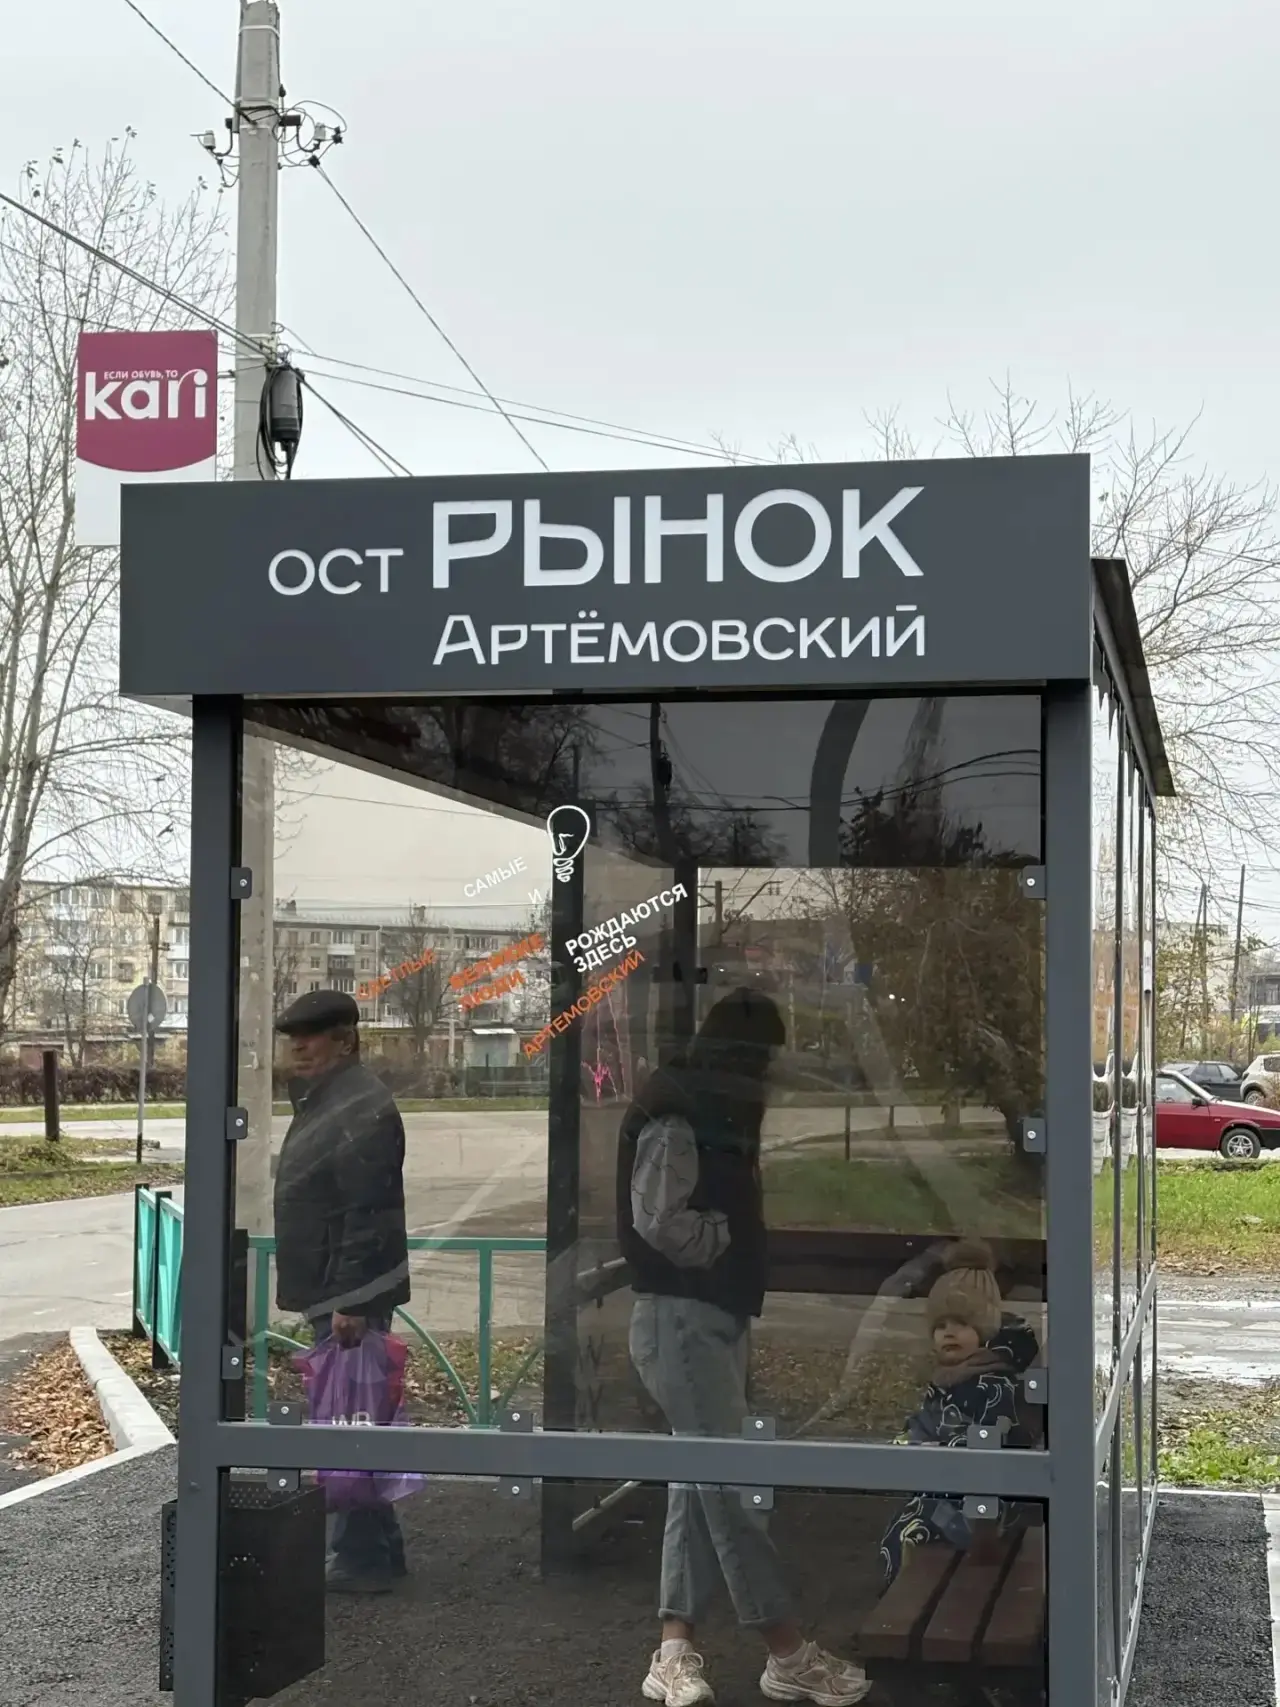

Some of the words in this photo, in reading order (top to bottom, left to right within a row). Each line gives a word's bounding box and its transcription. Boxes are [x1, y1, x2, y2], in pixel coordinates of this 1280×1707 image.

[84, 369, 208, 420] kari
[104, 371, 129, 380] ЕСЛИ
[165, 369, 179, 379] ТО
[432, 486, 926, 590] РЫНОК
[463, 856, 528, 898] САМЫЕ
[565, 883, 689, 957] РОЖДАЮТСЯ
[573, 933, 638, 973] ЗДЕСЬ
